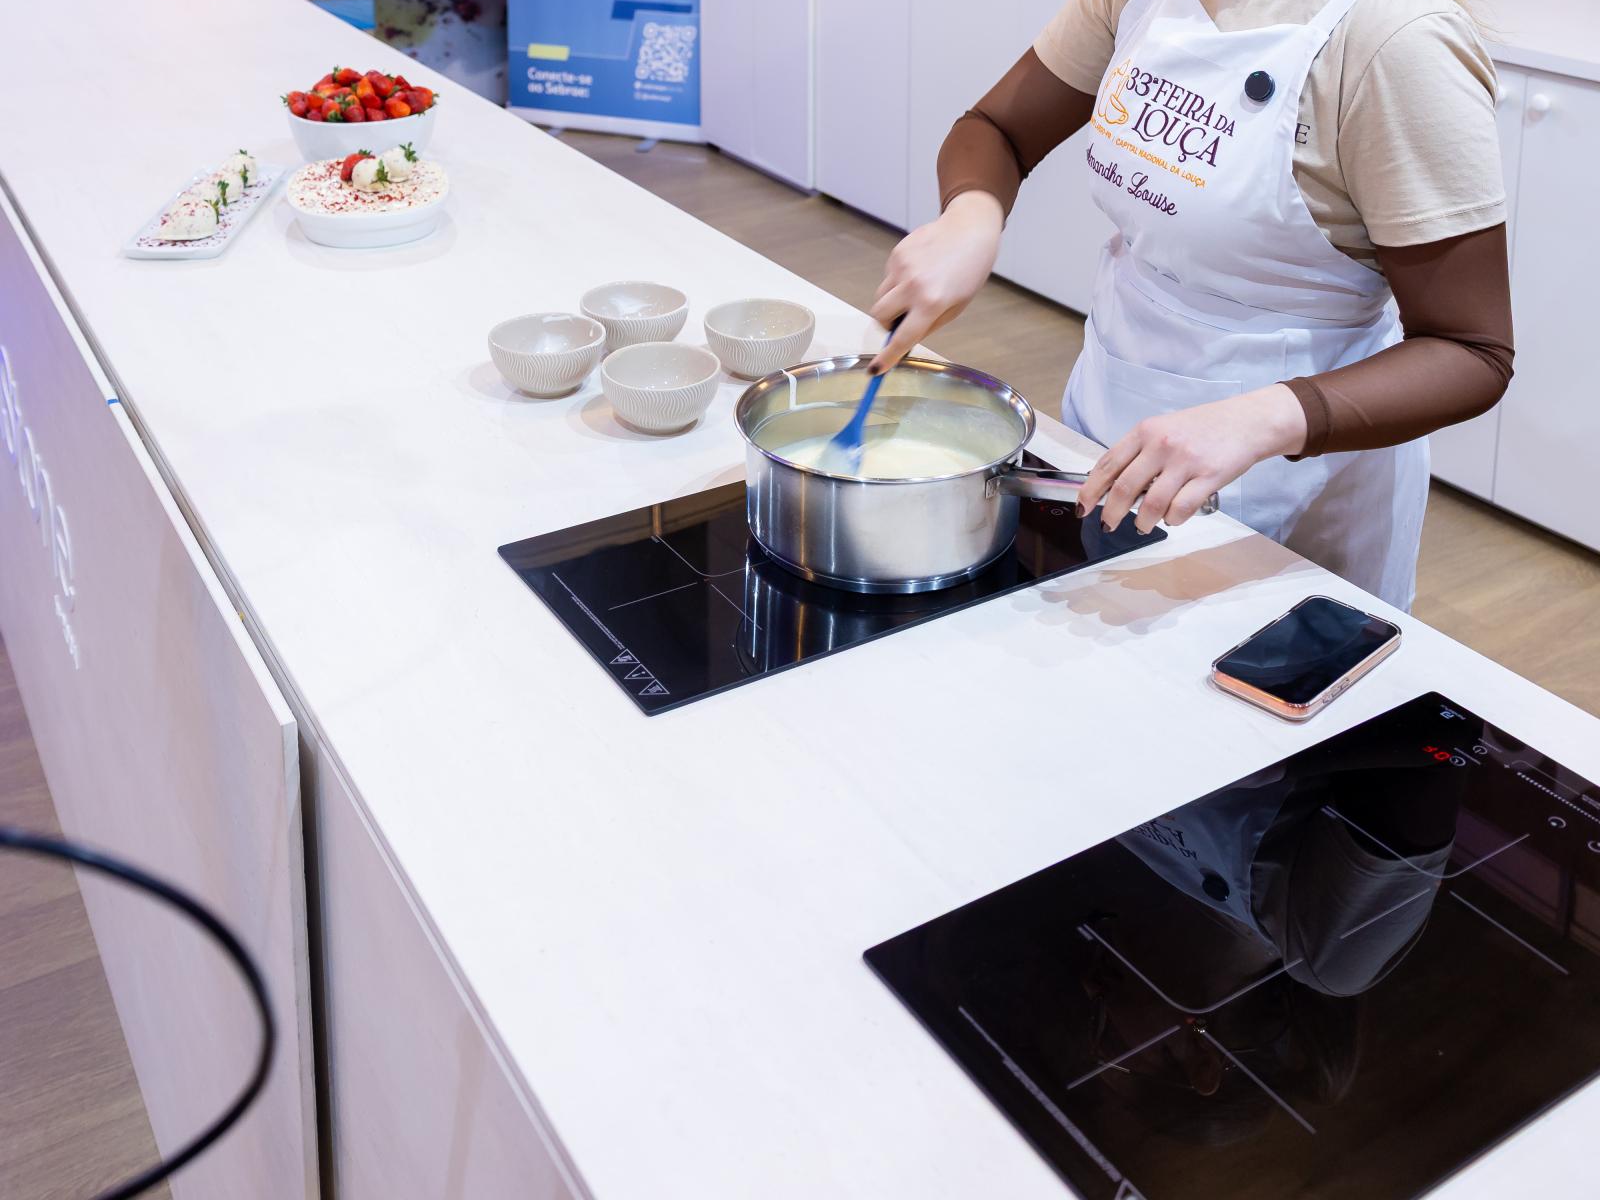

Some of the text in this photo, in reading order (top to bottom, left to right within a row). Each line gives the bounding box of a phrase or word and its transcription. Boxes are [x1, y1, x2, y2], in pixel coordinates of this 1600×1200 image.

[1131, 102, 1221, 168] LOUÇA
[1151, 78, 1216, 127] FEIRA
[1213, 114, 1236, 137] DA
[1115, 137, 1206, 188] CAPITAL NACIONAL DA LOUÇA
[1127, 172, 1178, 216] Louise
